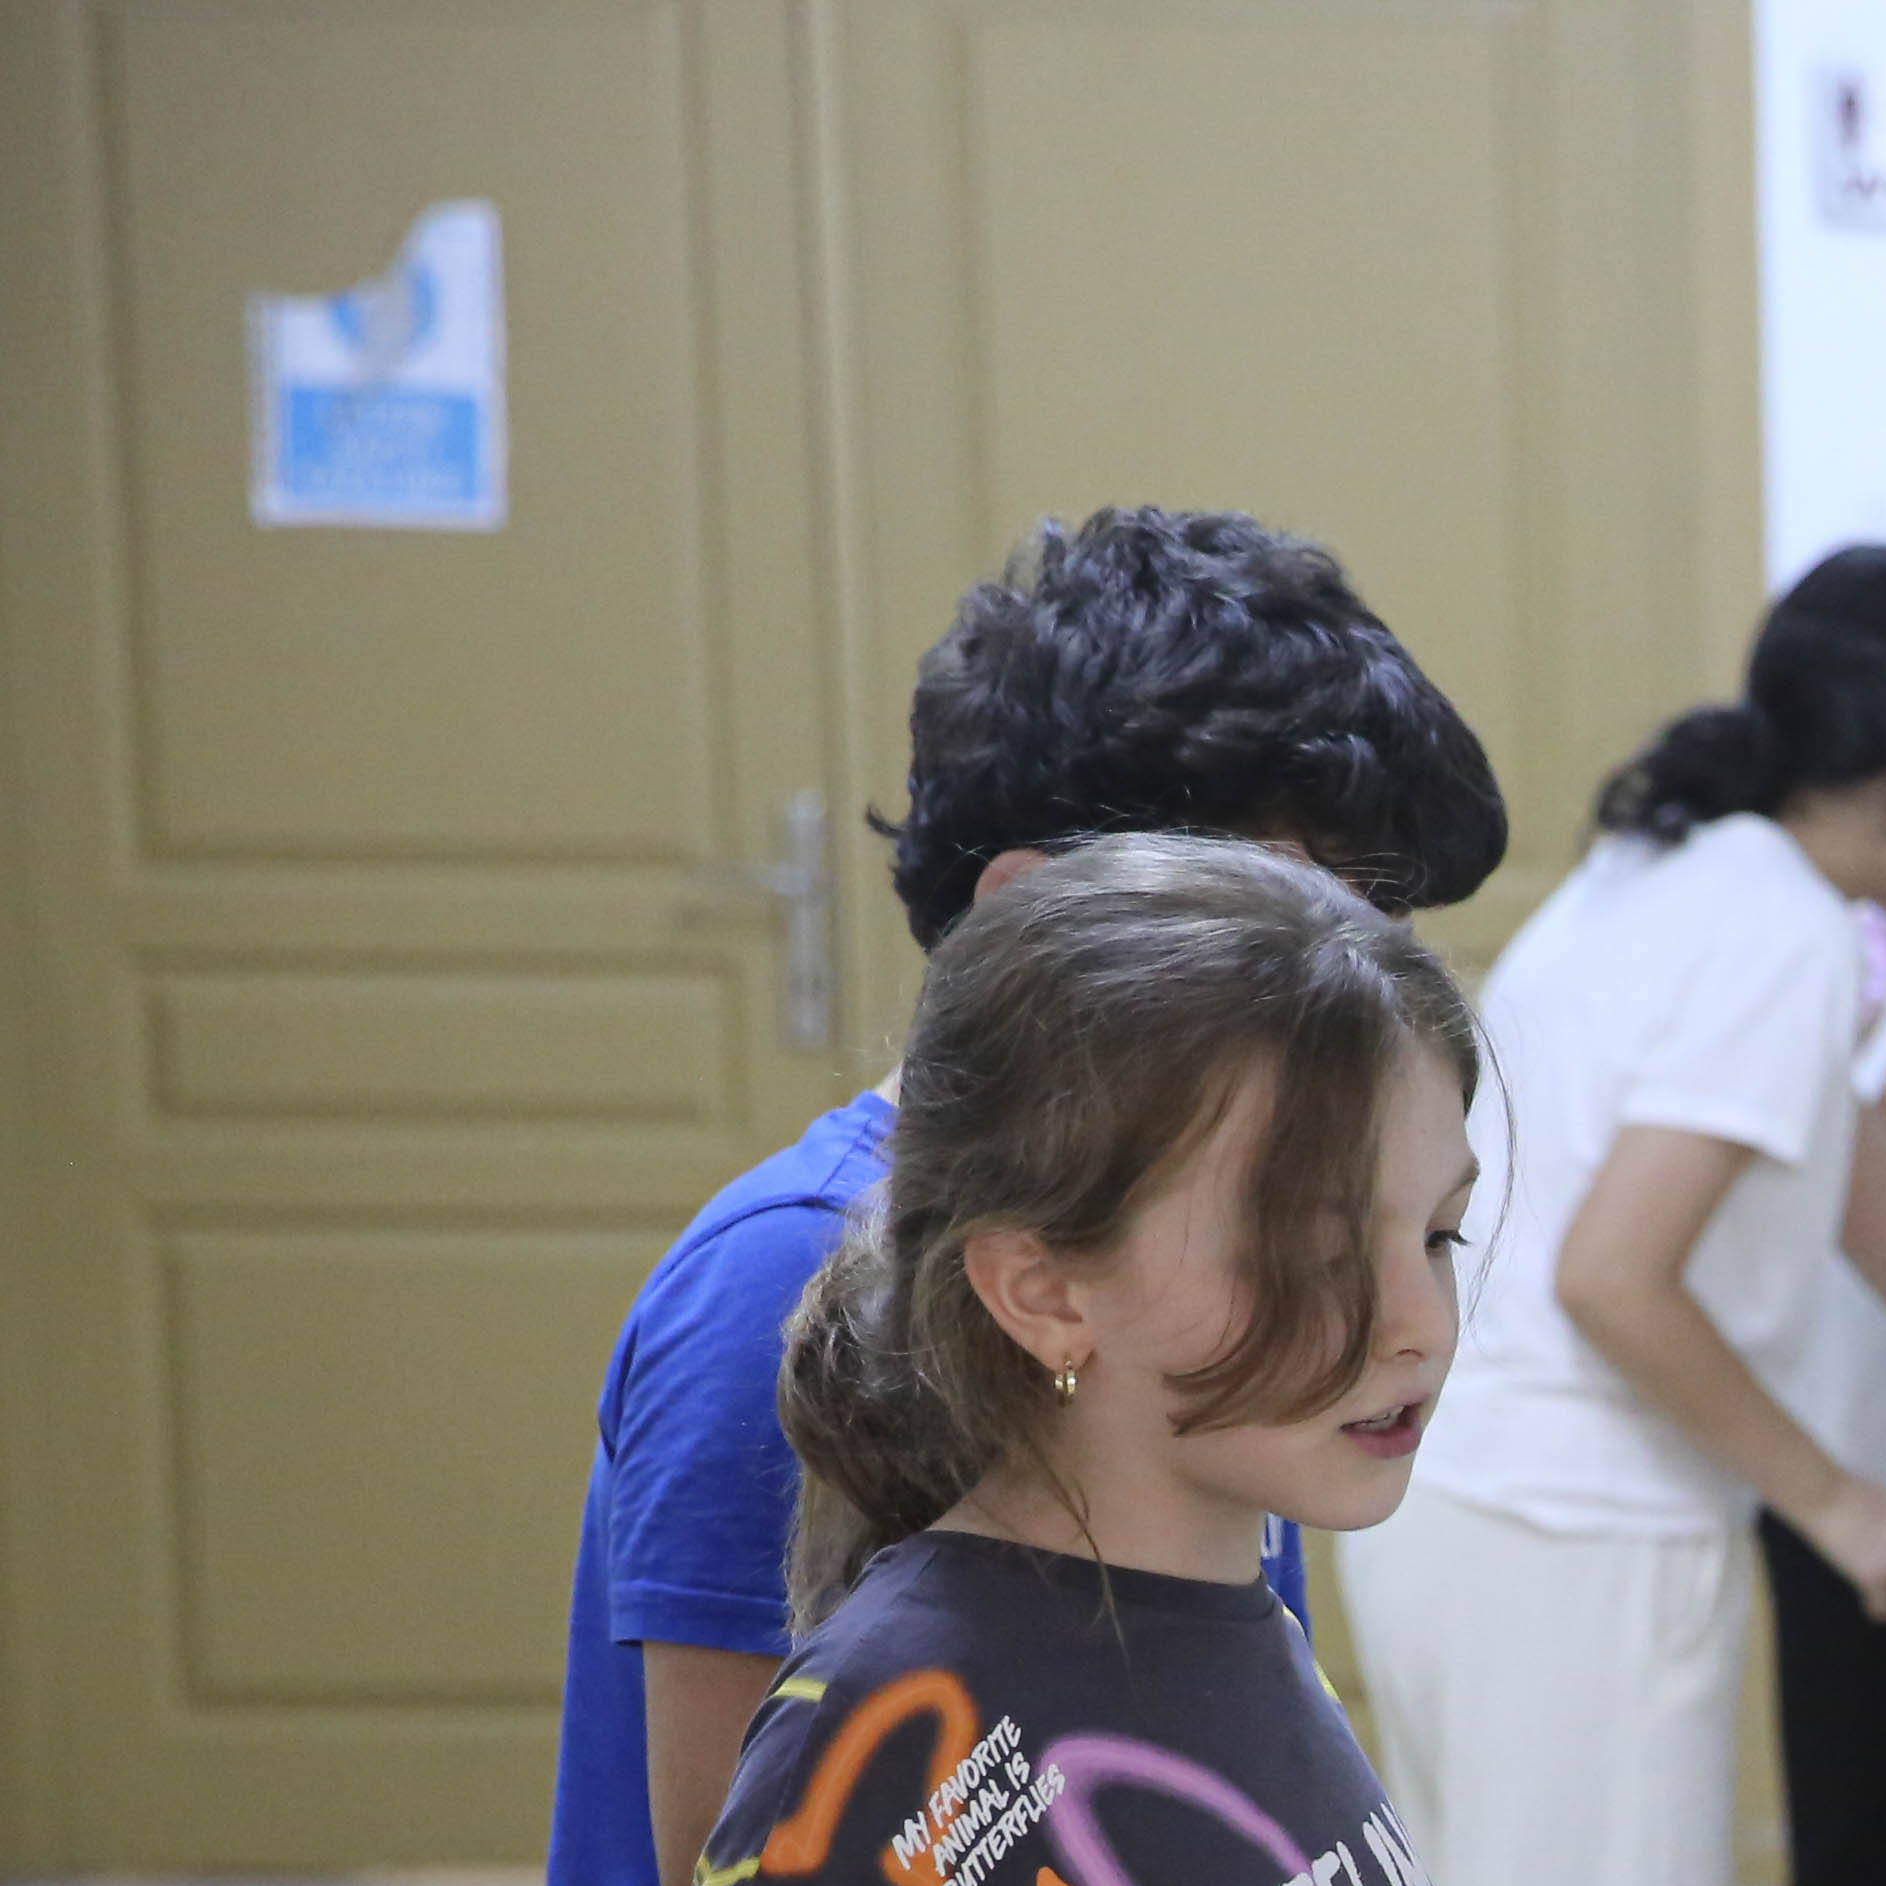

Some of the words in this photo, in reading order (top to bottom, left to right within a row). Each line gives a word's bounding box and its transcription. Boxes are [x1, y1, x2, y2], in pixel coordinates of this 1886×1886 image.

[892, 1811, 932, 1870] MY
[928, 1714, 1022, 1829] FAVORITE
[932, 1779, 1010, 1878] ANIMAL
[1004, 1751, 1031, 1791] IS
